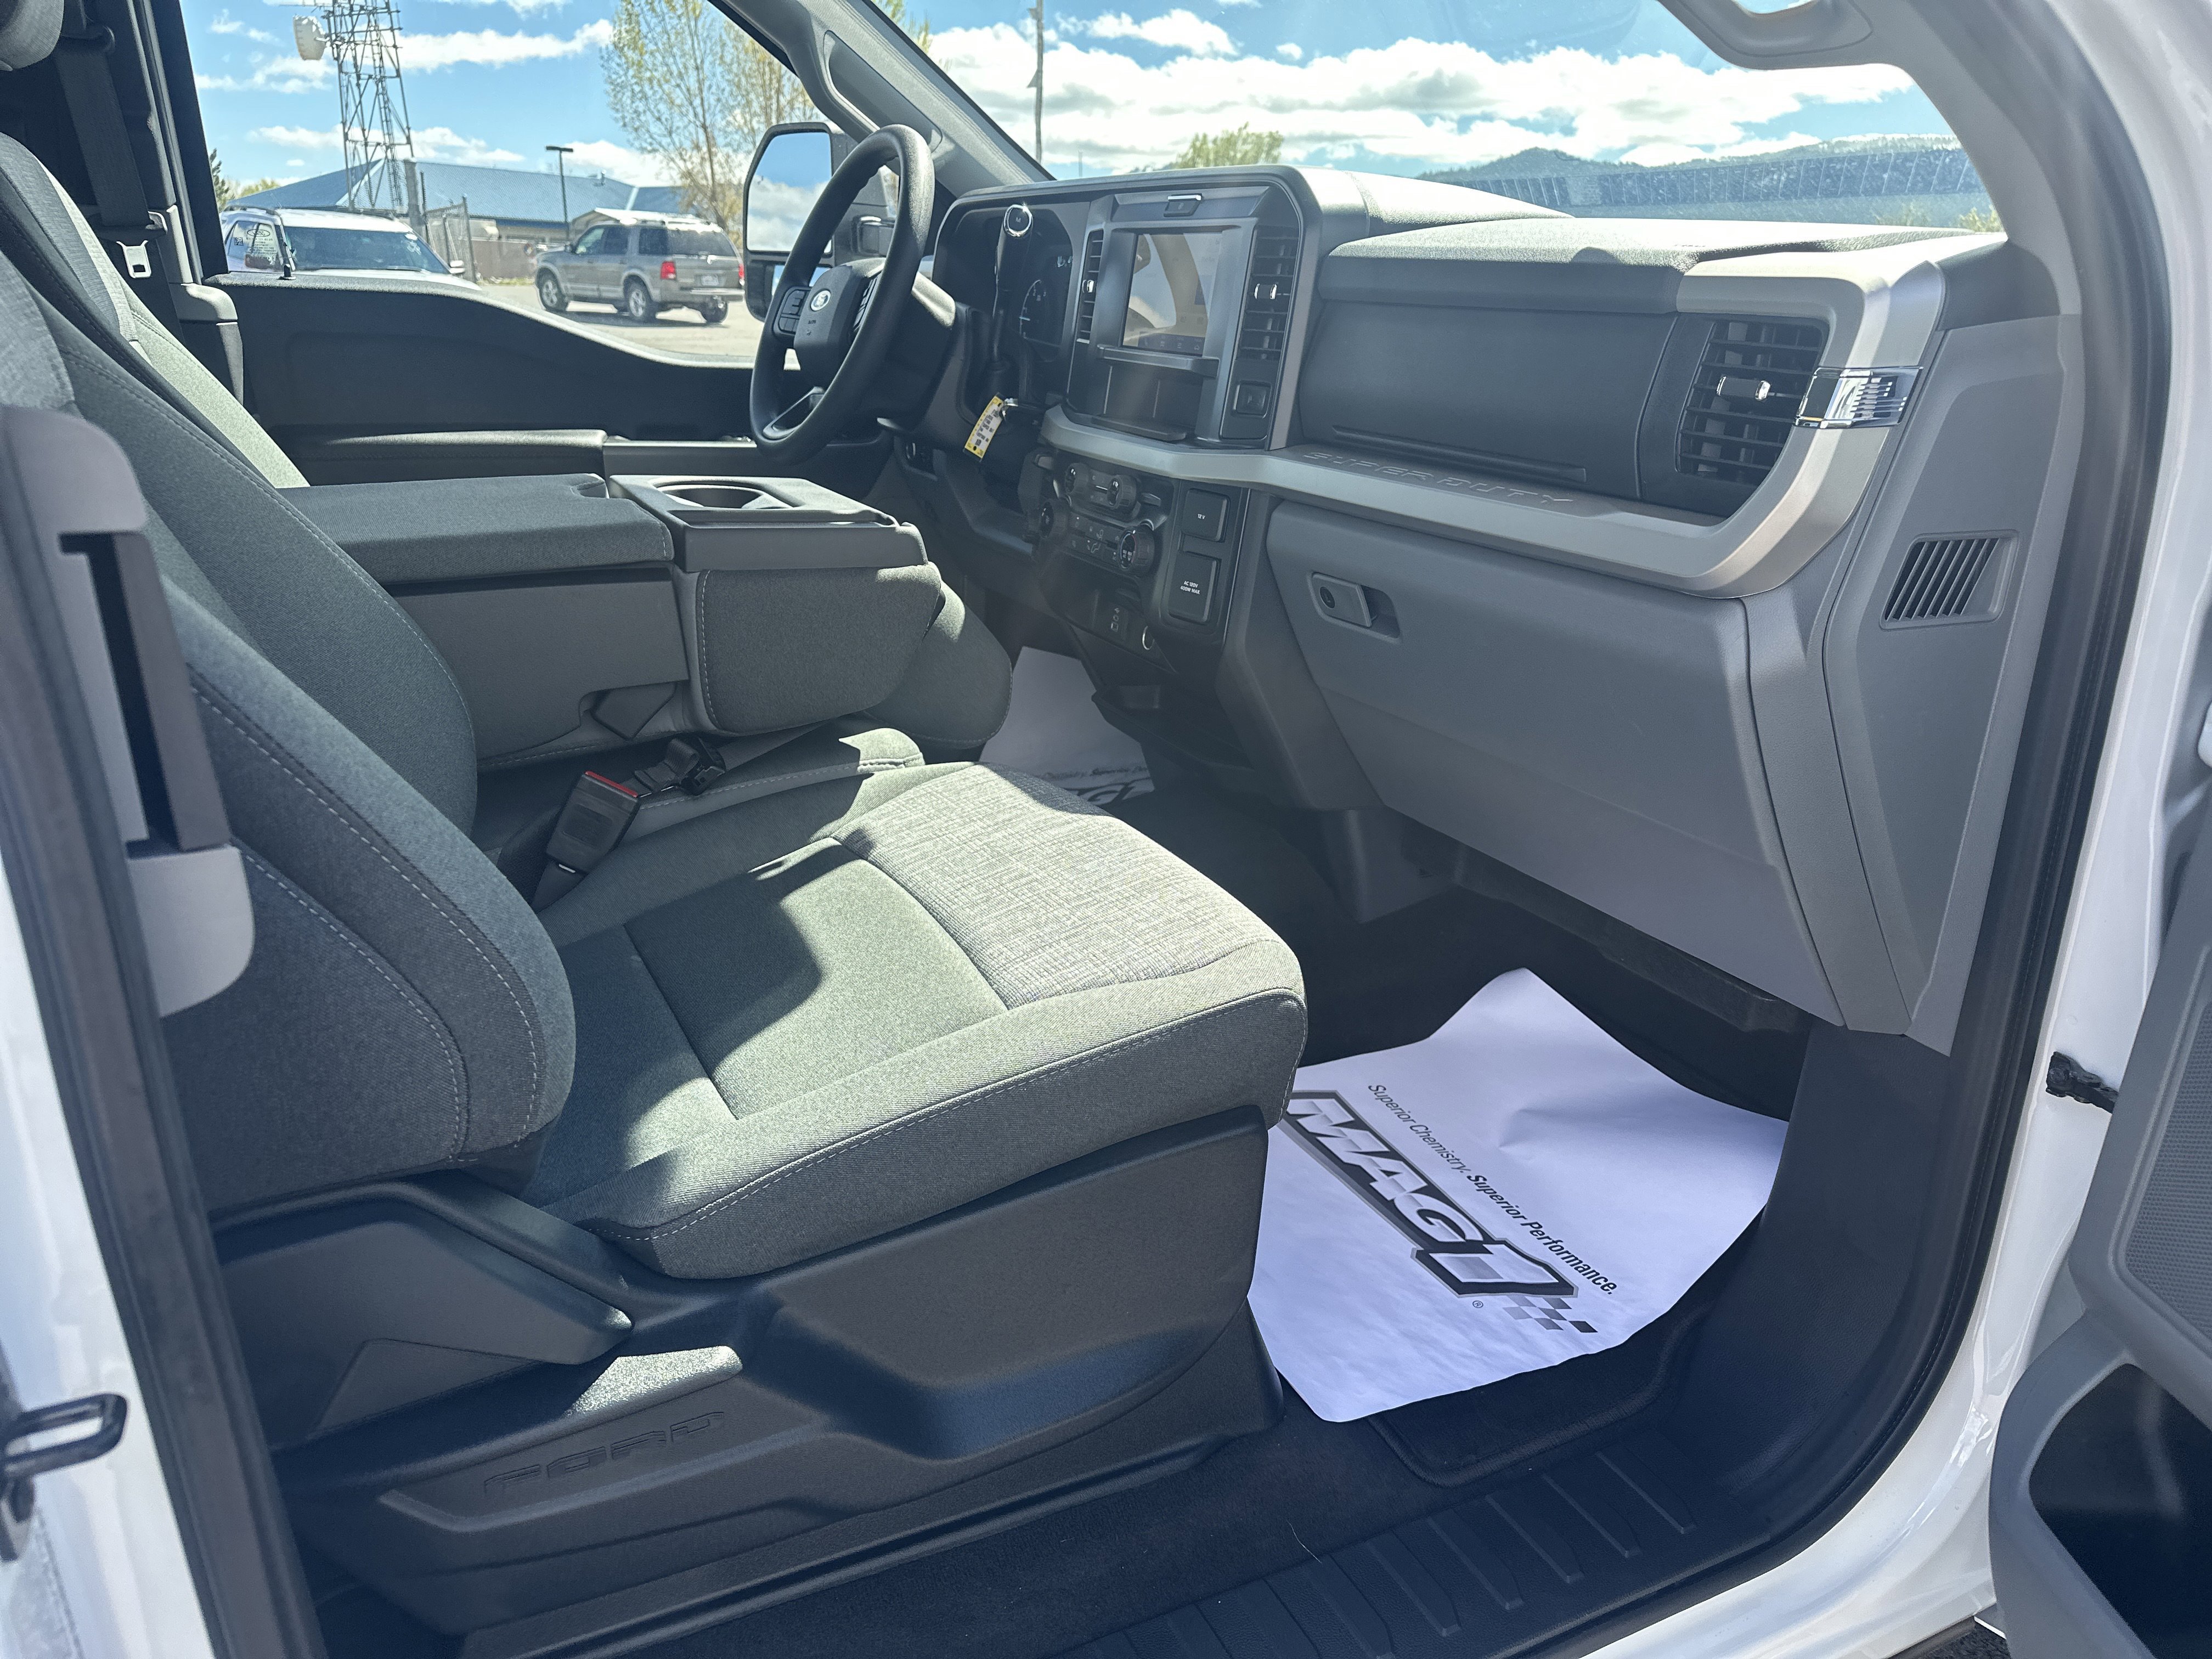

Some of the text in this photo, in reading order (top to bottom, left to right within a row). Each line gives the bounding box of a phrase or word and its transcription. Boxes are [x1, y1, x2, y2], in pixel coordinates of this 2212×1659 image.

[1304, 452, 1574, 504] SUPER DUTY
[1368, 1085, 1617, 1295] Superior Chemistry. Superior Performance.
[483, 1411, 725, 1496] FORD
